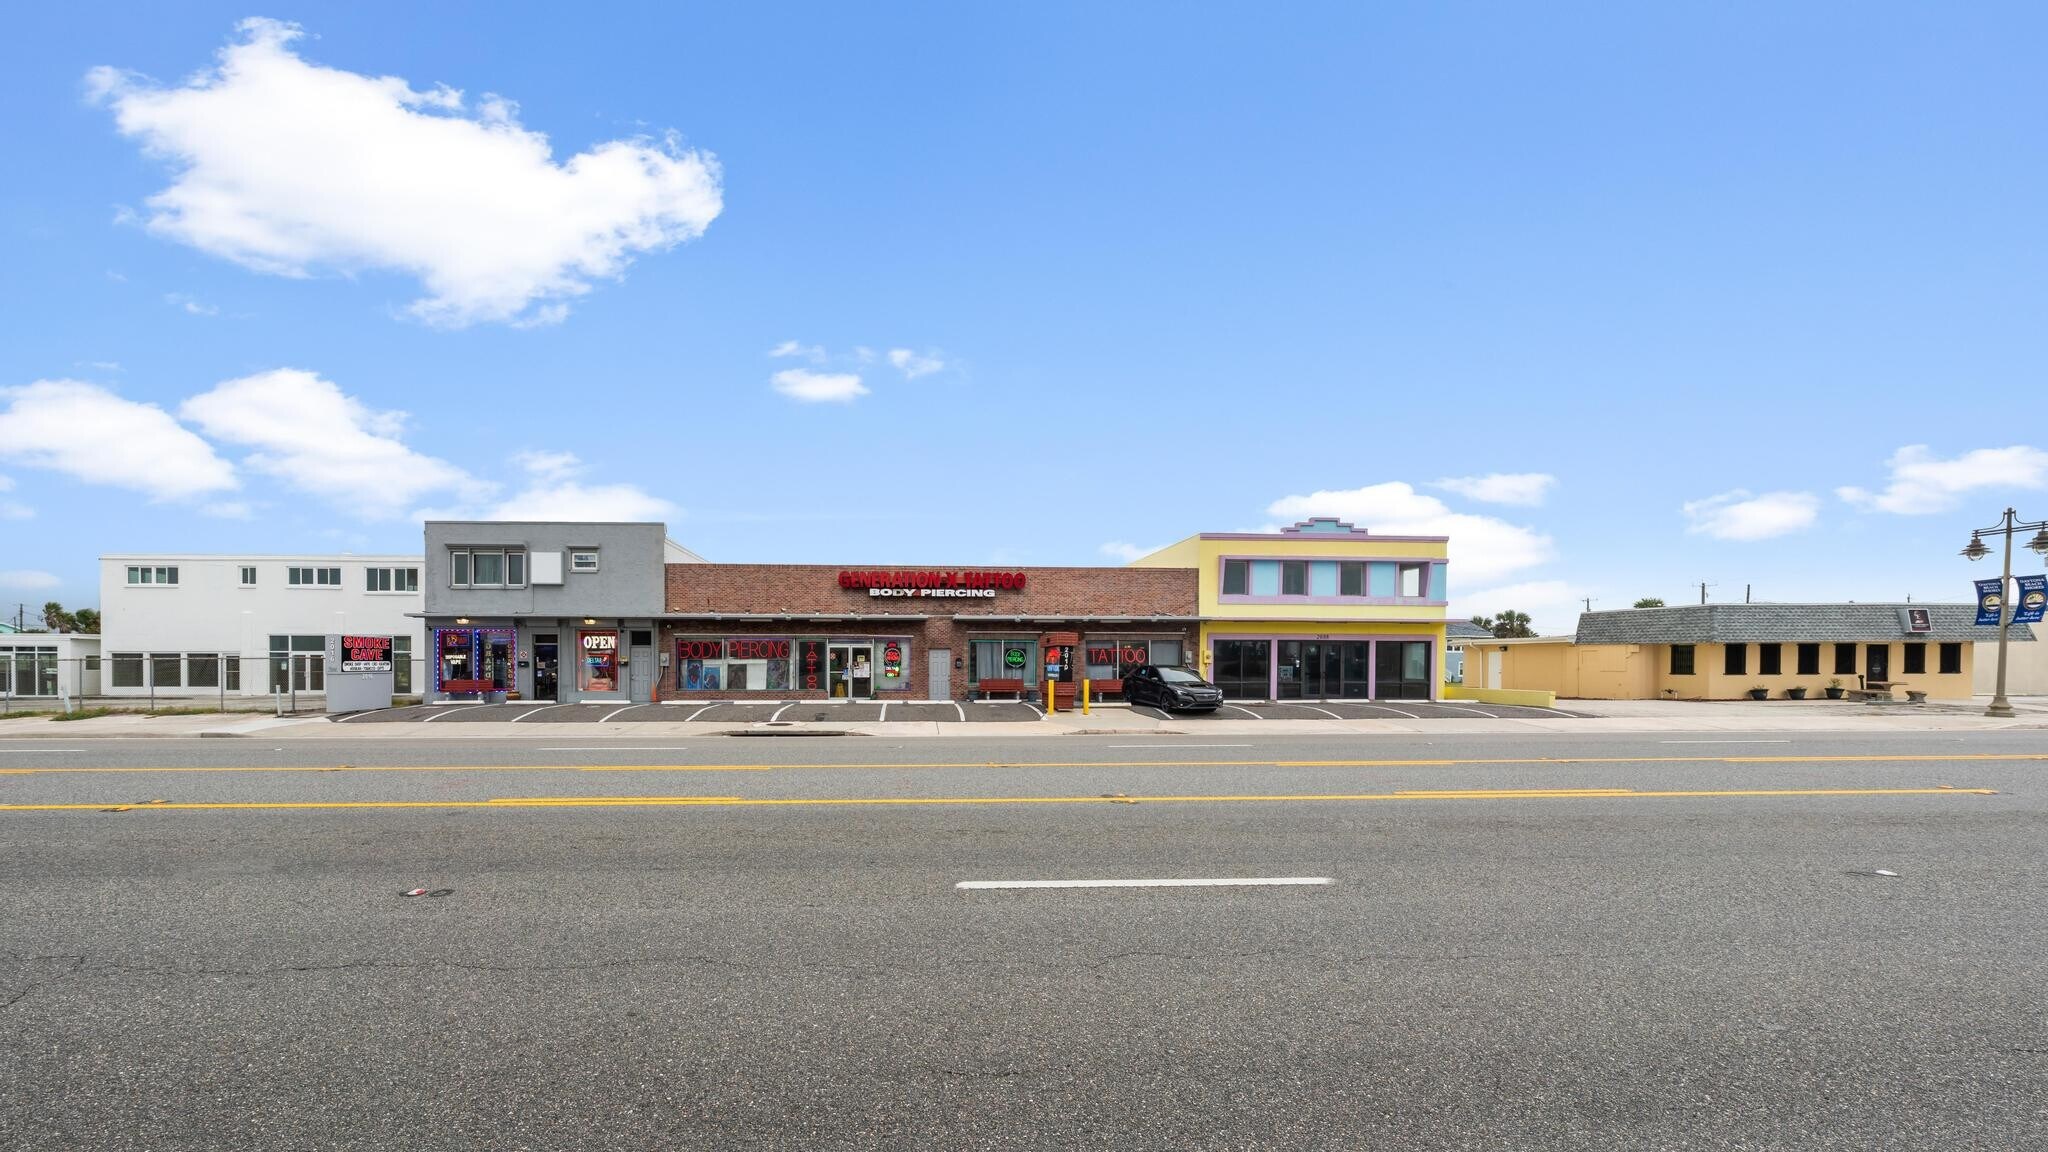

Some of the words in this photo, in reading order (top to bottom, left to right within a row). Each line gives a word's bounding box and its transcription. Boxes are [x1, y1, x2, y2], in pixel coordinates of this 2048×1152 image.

[838, 571, 940, 588] GENERATION
[946, 571, 957, 587] X
[964, 571, 1026, 589] TATTOO
[869, 588, 916, 596] BODY
[920, 588, 996, 597] PIERCING
[344, 636, 390, 649] SMOKE
[583, 636, 616, 649] OPEN
[680, 641, 722, 659] BODY
[728, 640, 789, 659] PIERCING
[351, 649, 383, 661] CAVE
[1088, 648, 1146, 663] TATTOO
[806, 642, 818, 691] TATTOO
